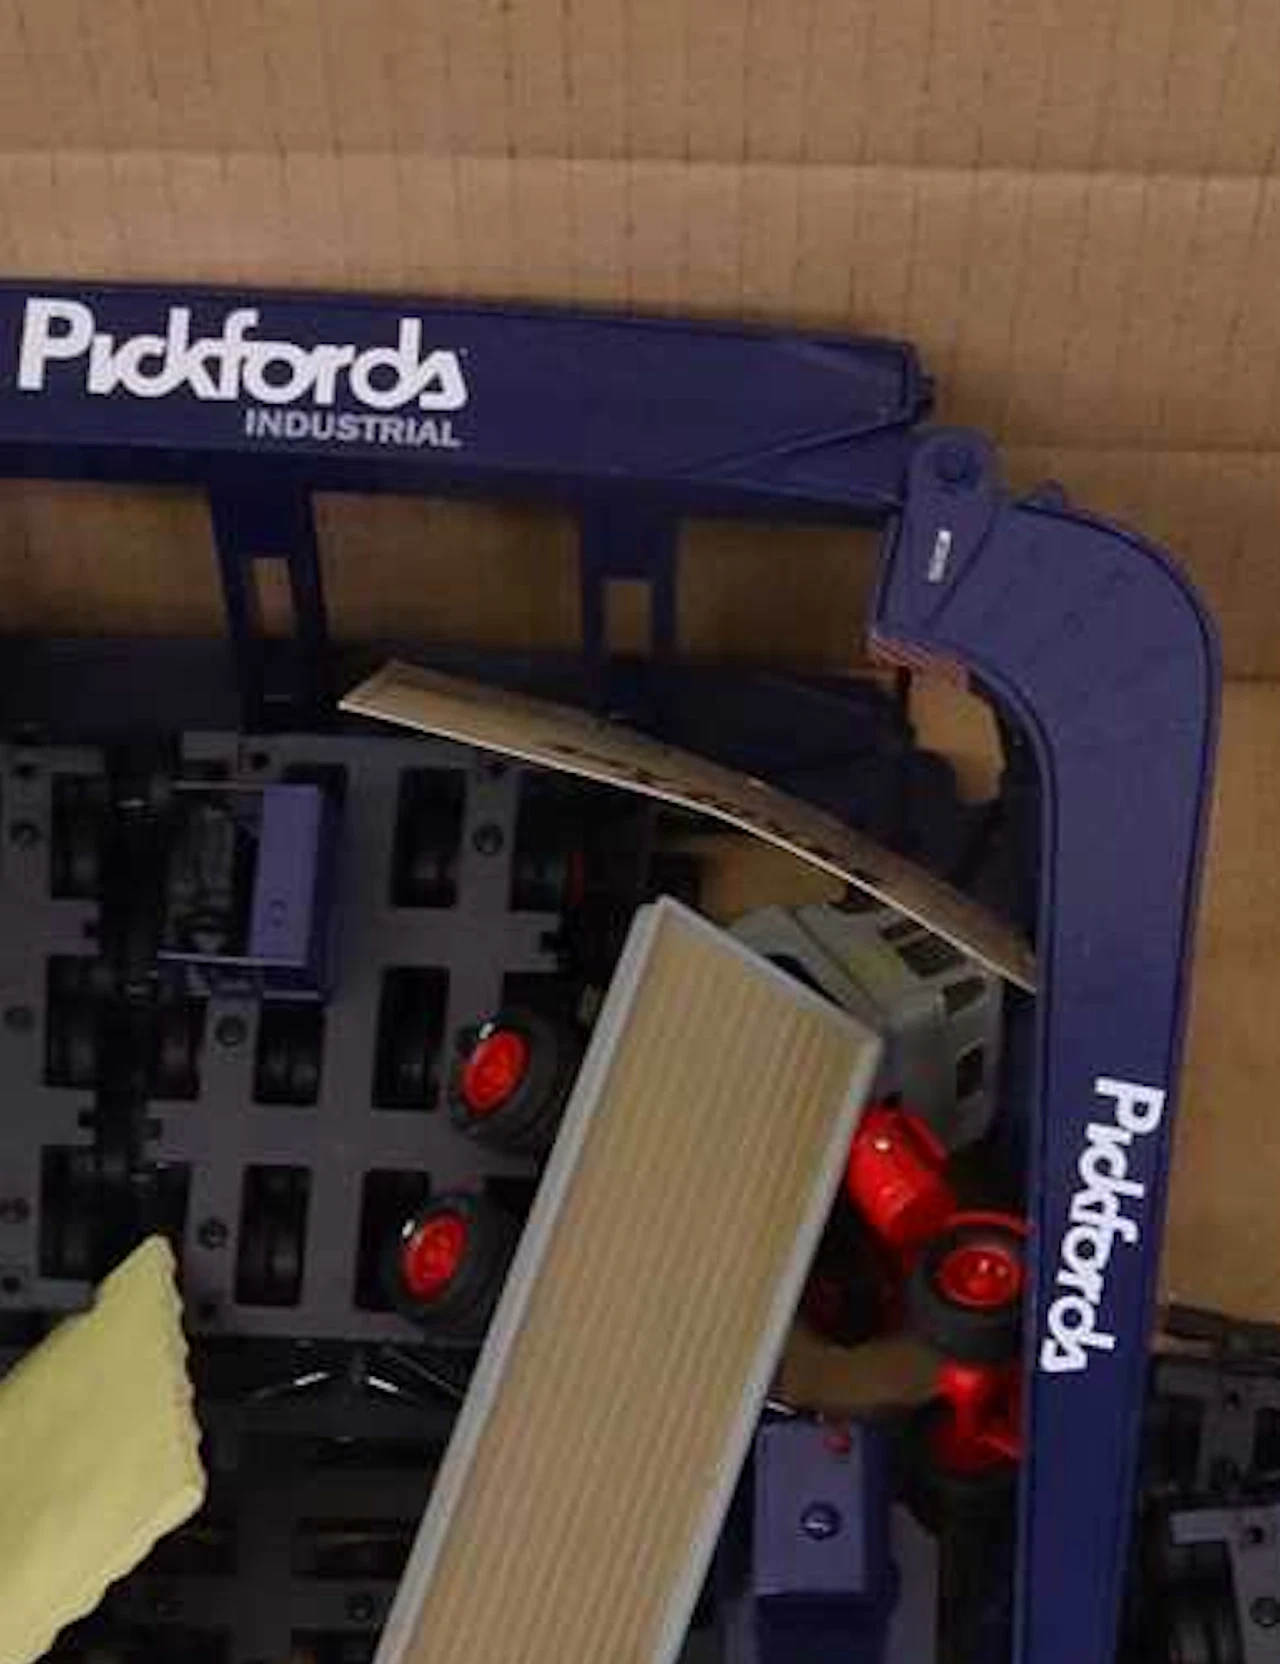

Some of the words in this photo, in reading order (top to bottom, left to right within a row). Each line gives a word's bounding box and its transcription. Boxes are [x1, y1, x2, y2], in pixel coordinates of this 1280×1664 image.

[16, 297, 467, 410] Pickfords
[245, 408, 462, 448] INDUSTRIAL
[1040, 1076, 1166, 1373] Pickfords
